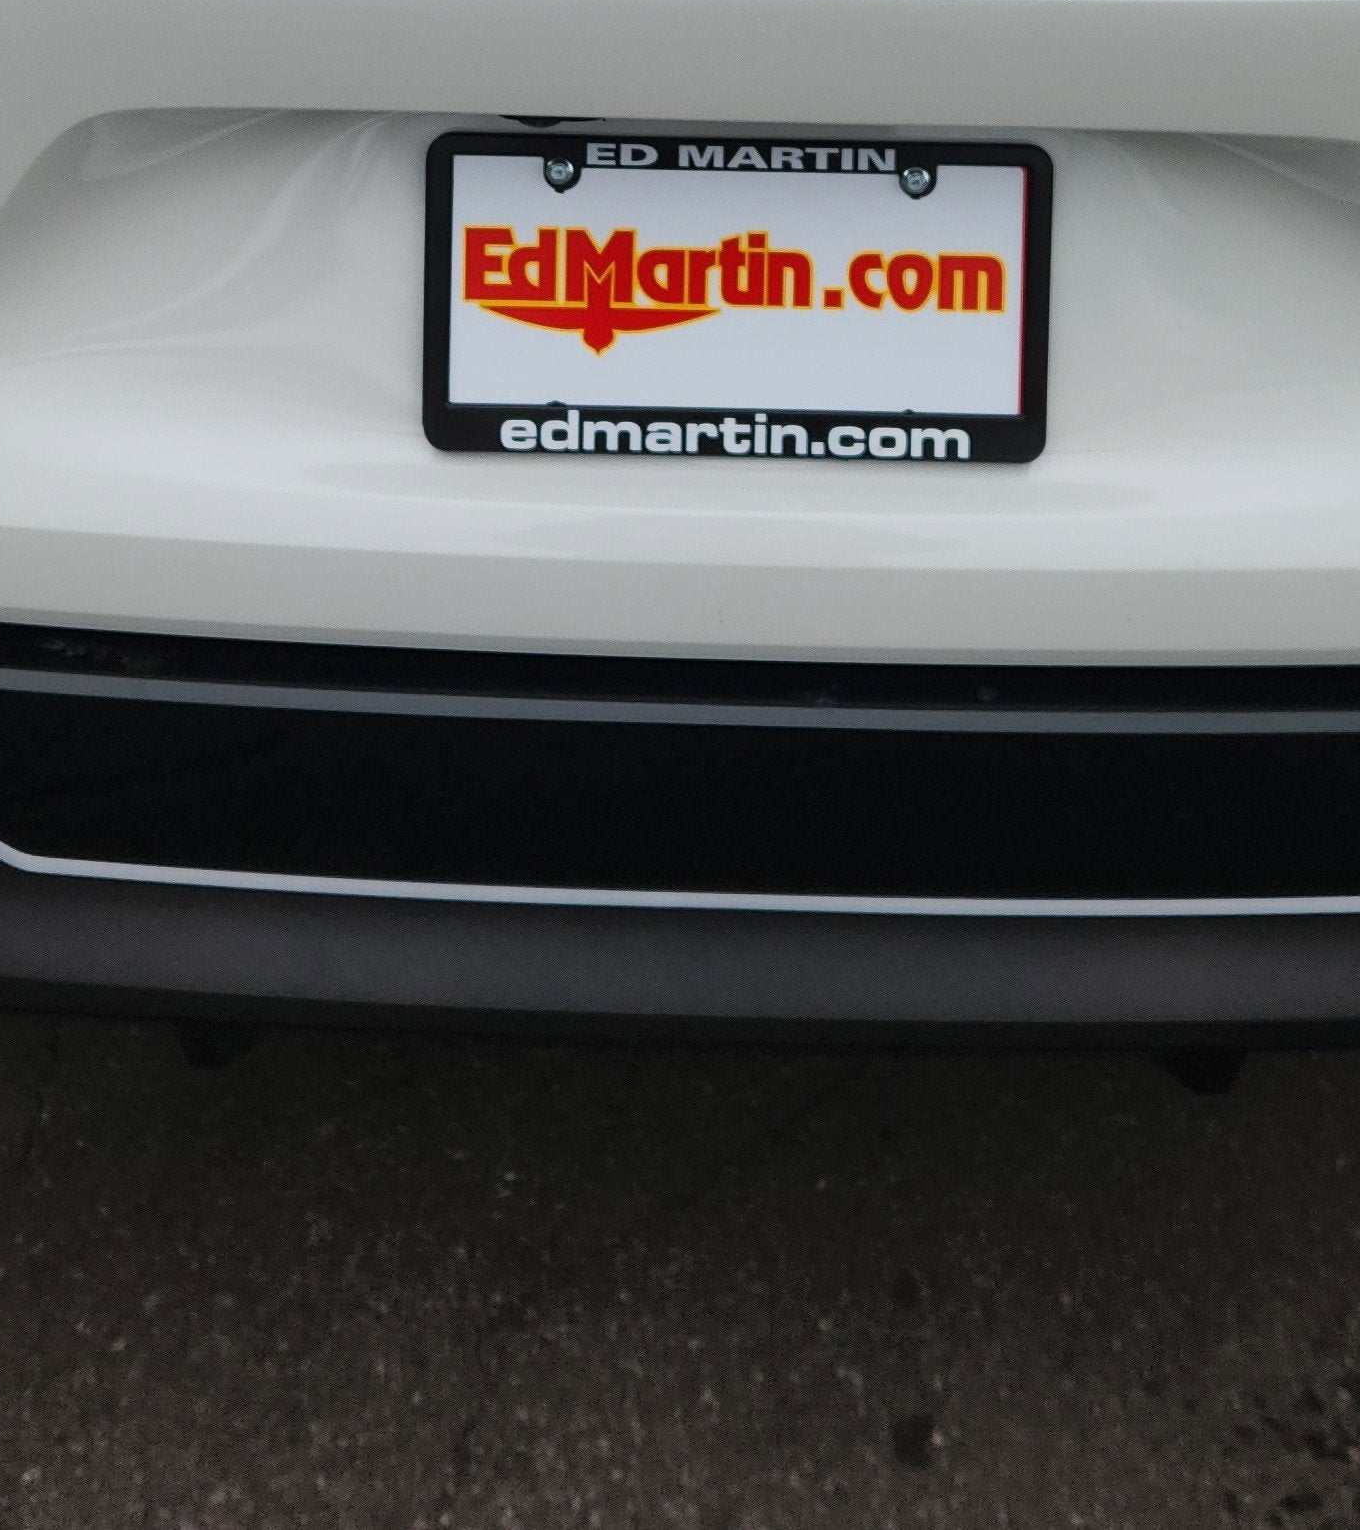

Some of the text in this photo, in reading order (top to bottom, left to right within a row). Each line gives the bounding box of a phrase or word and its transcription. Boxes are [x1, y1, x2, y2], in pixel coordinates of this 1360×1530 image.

[586, 143, 897, 173] ED MARTIN
[463, 225, 1006, 314] EdMartin.com
[500, 408, 971, 460] edmartin.com
